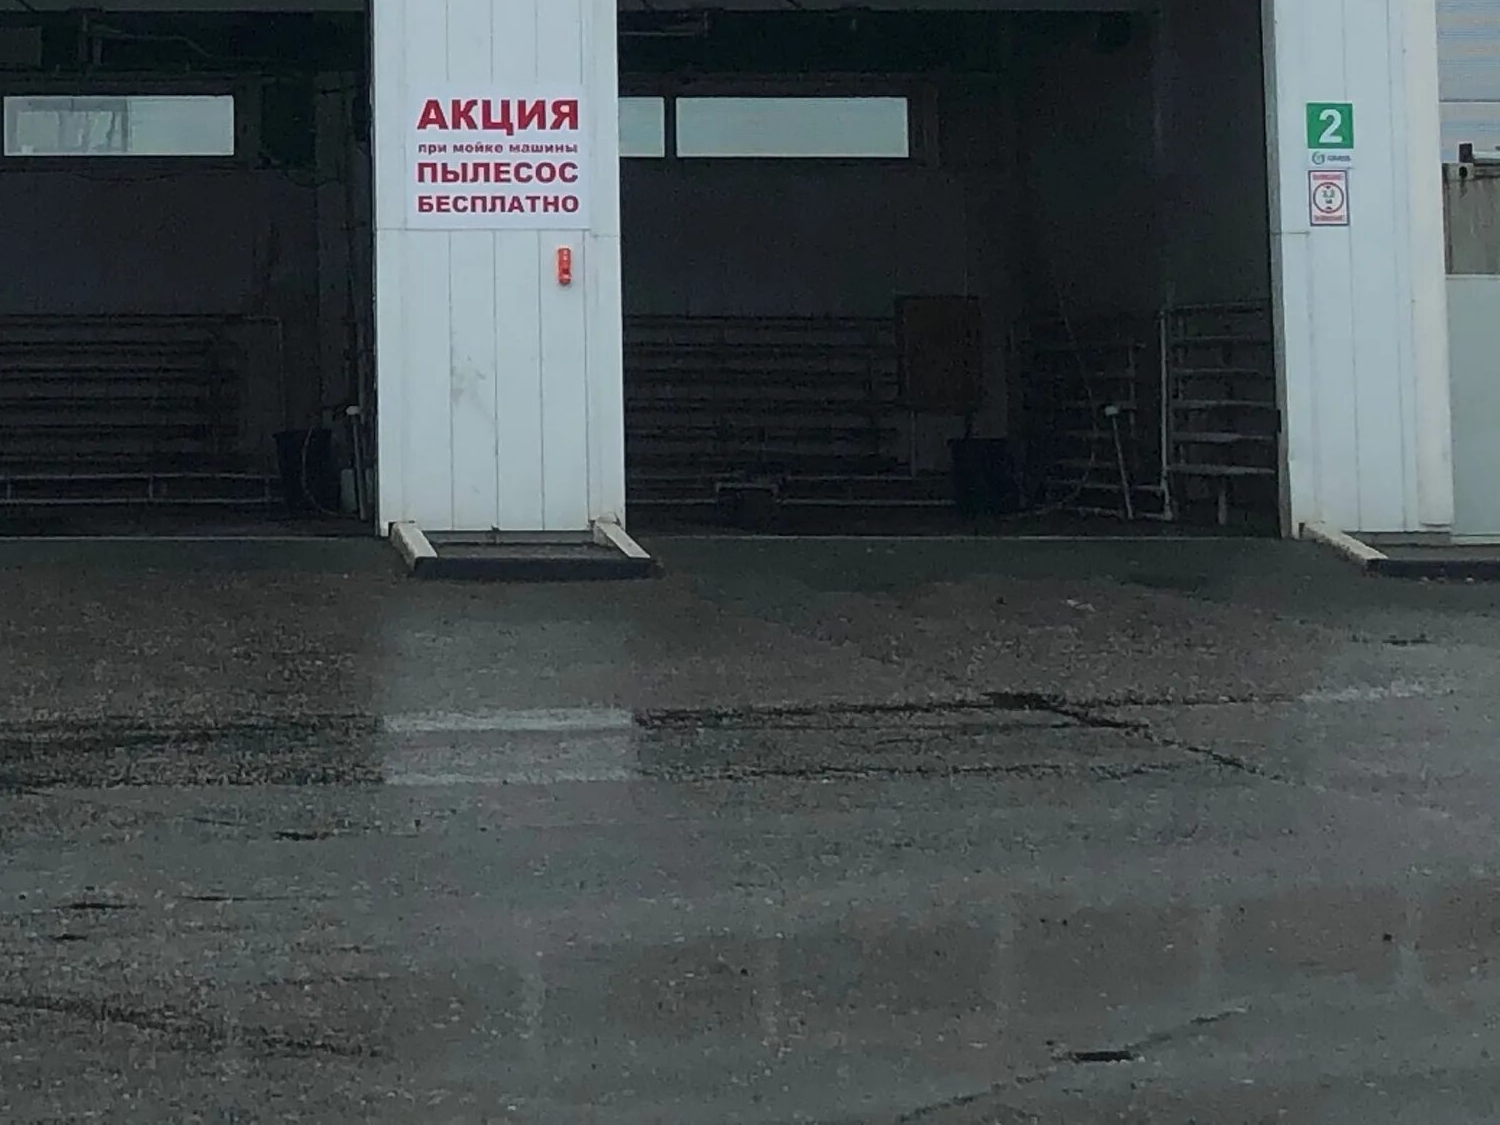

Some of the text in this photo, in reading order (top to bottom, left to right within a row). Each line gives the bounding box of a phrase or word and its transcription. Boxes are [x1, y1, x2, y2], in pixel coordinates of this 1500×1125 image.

[416, 98, 580, 136] АКЦИЯ
[1319, 109, 1343, 143] 2
[417, 140, 579, 156] при мойке машины
[416, 161, 580, 184] ПЫЛЕСОС
[417, 194, 581, 214] БЕСПЛАТНО
